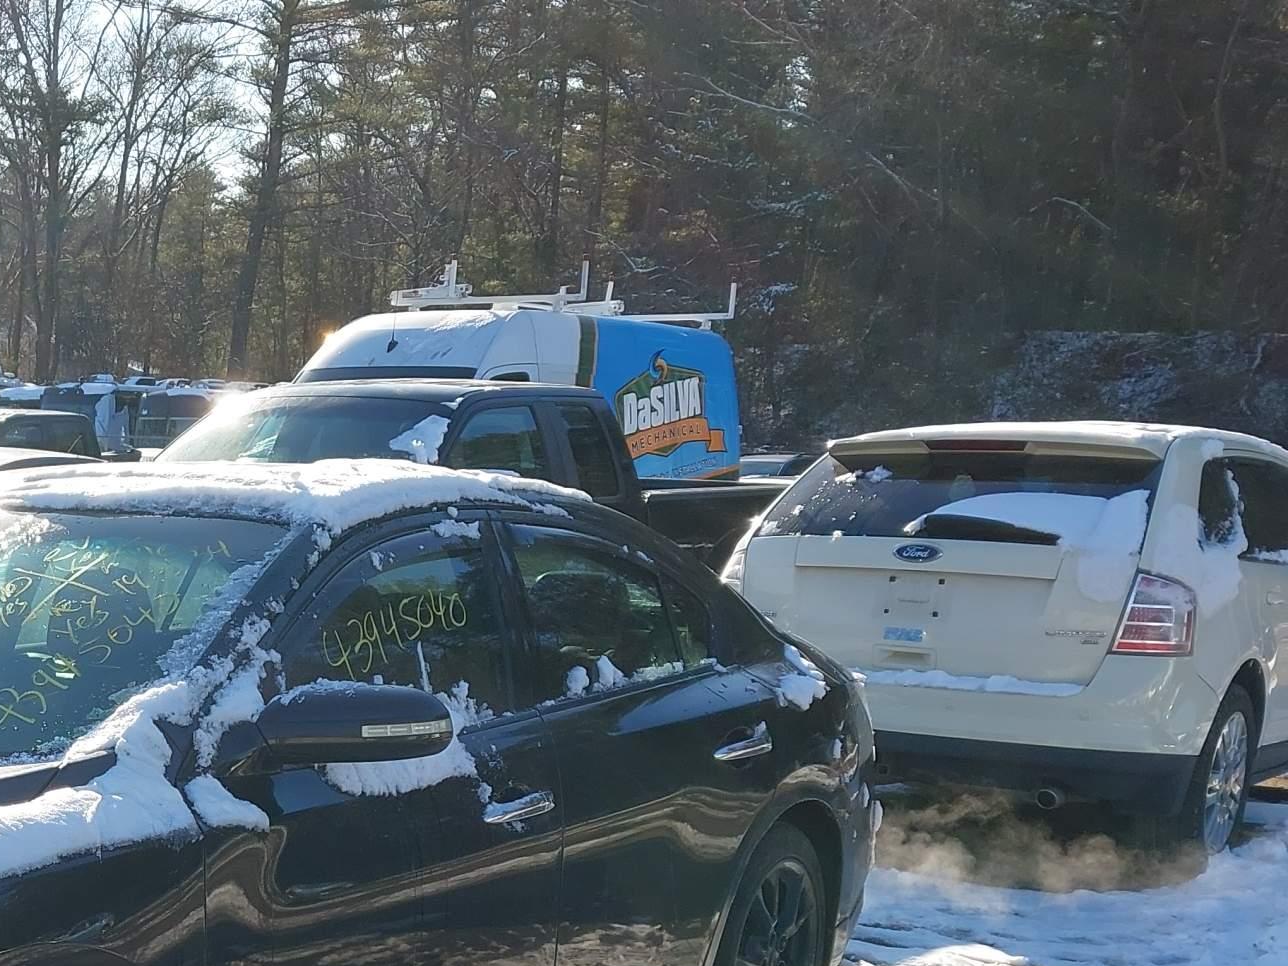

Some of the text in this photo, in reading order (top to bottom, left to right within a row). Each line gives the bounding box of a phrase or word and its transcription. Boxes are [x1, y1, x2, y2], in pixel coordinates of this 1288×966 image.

[623, 376, 702, 435] DaSILVA
[631, 425, 701, 453] MECHANICAL
[323, 589, 467, 681] 43945040
